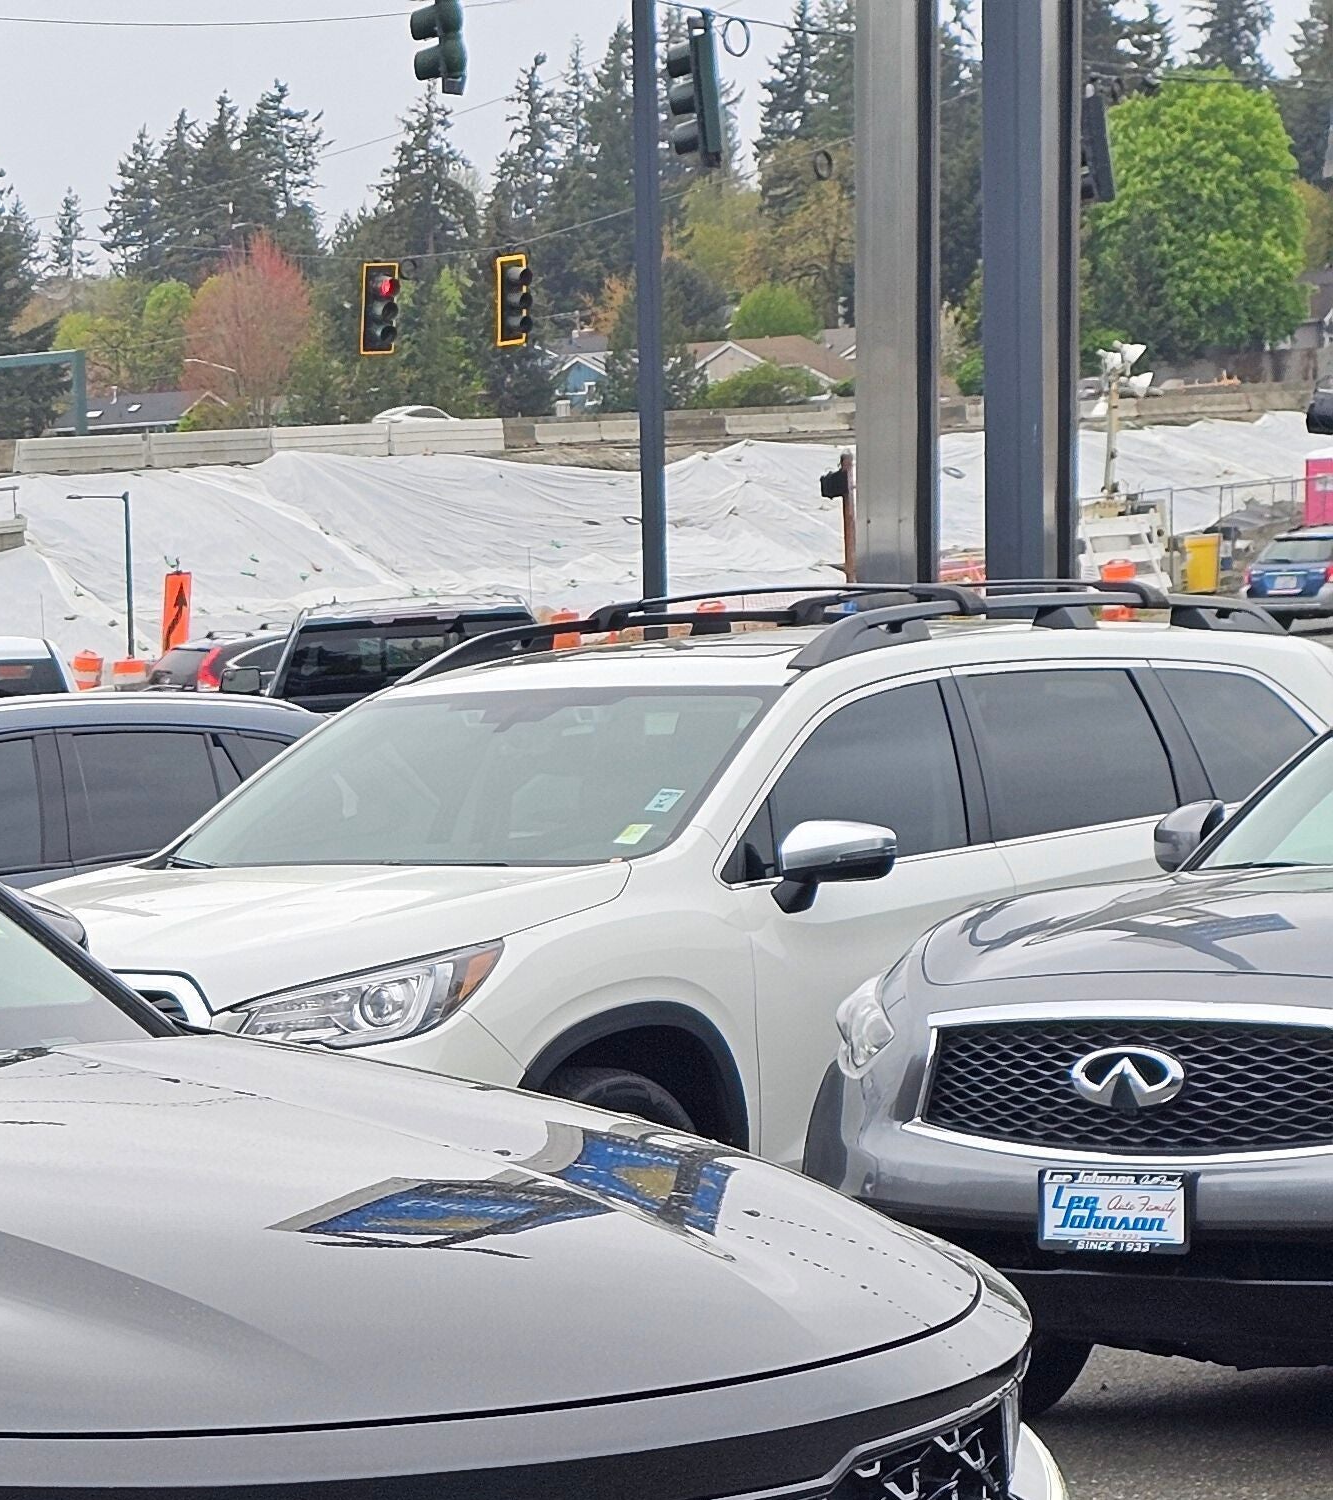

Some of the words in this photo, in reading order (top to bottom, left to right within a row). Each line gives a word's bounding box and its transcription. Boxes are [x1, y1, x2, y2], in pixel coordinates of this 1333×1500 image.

[1052, 1185, 1101, 1209] Lee
[1054, 1207, 1167, 1232] Johnson
[1076, 1240, 1115, 1251] SINCE
[1119, 1241, 1151, 1252] 1933
